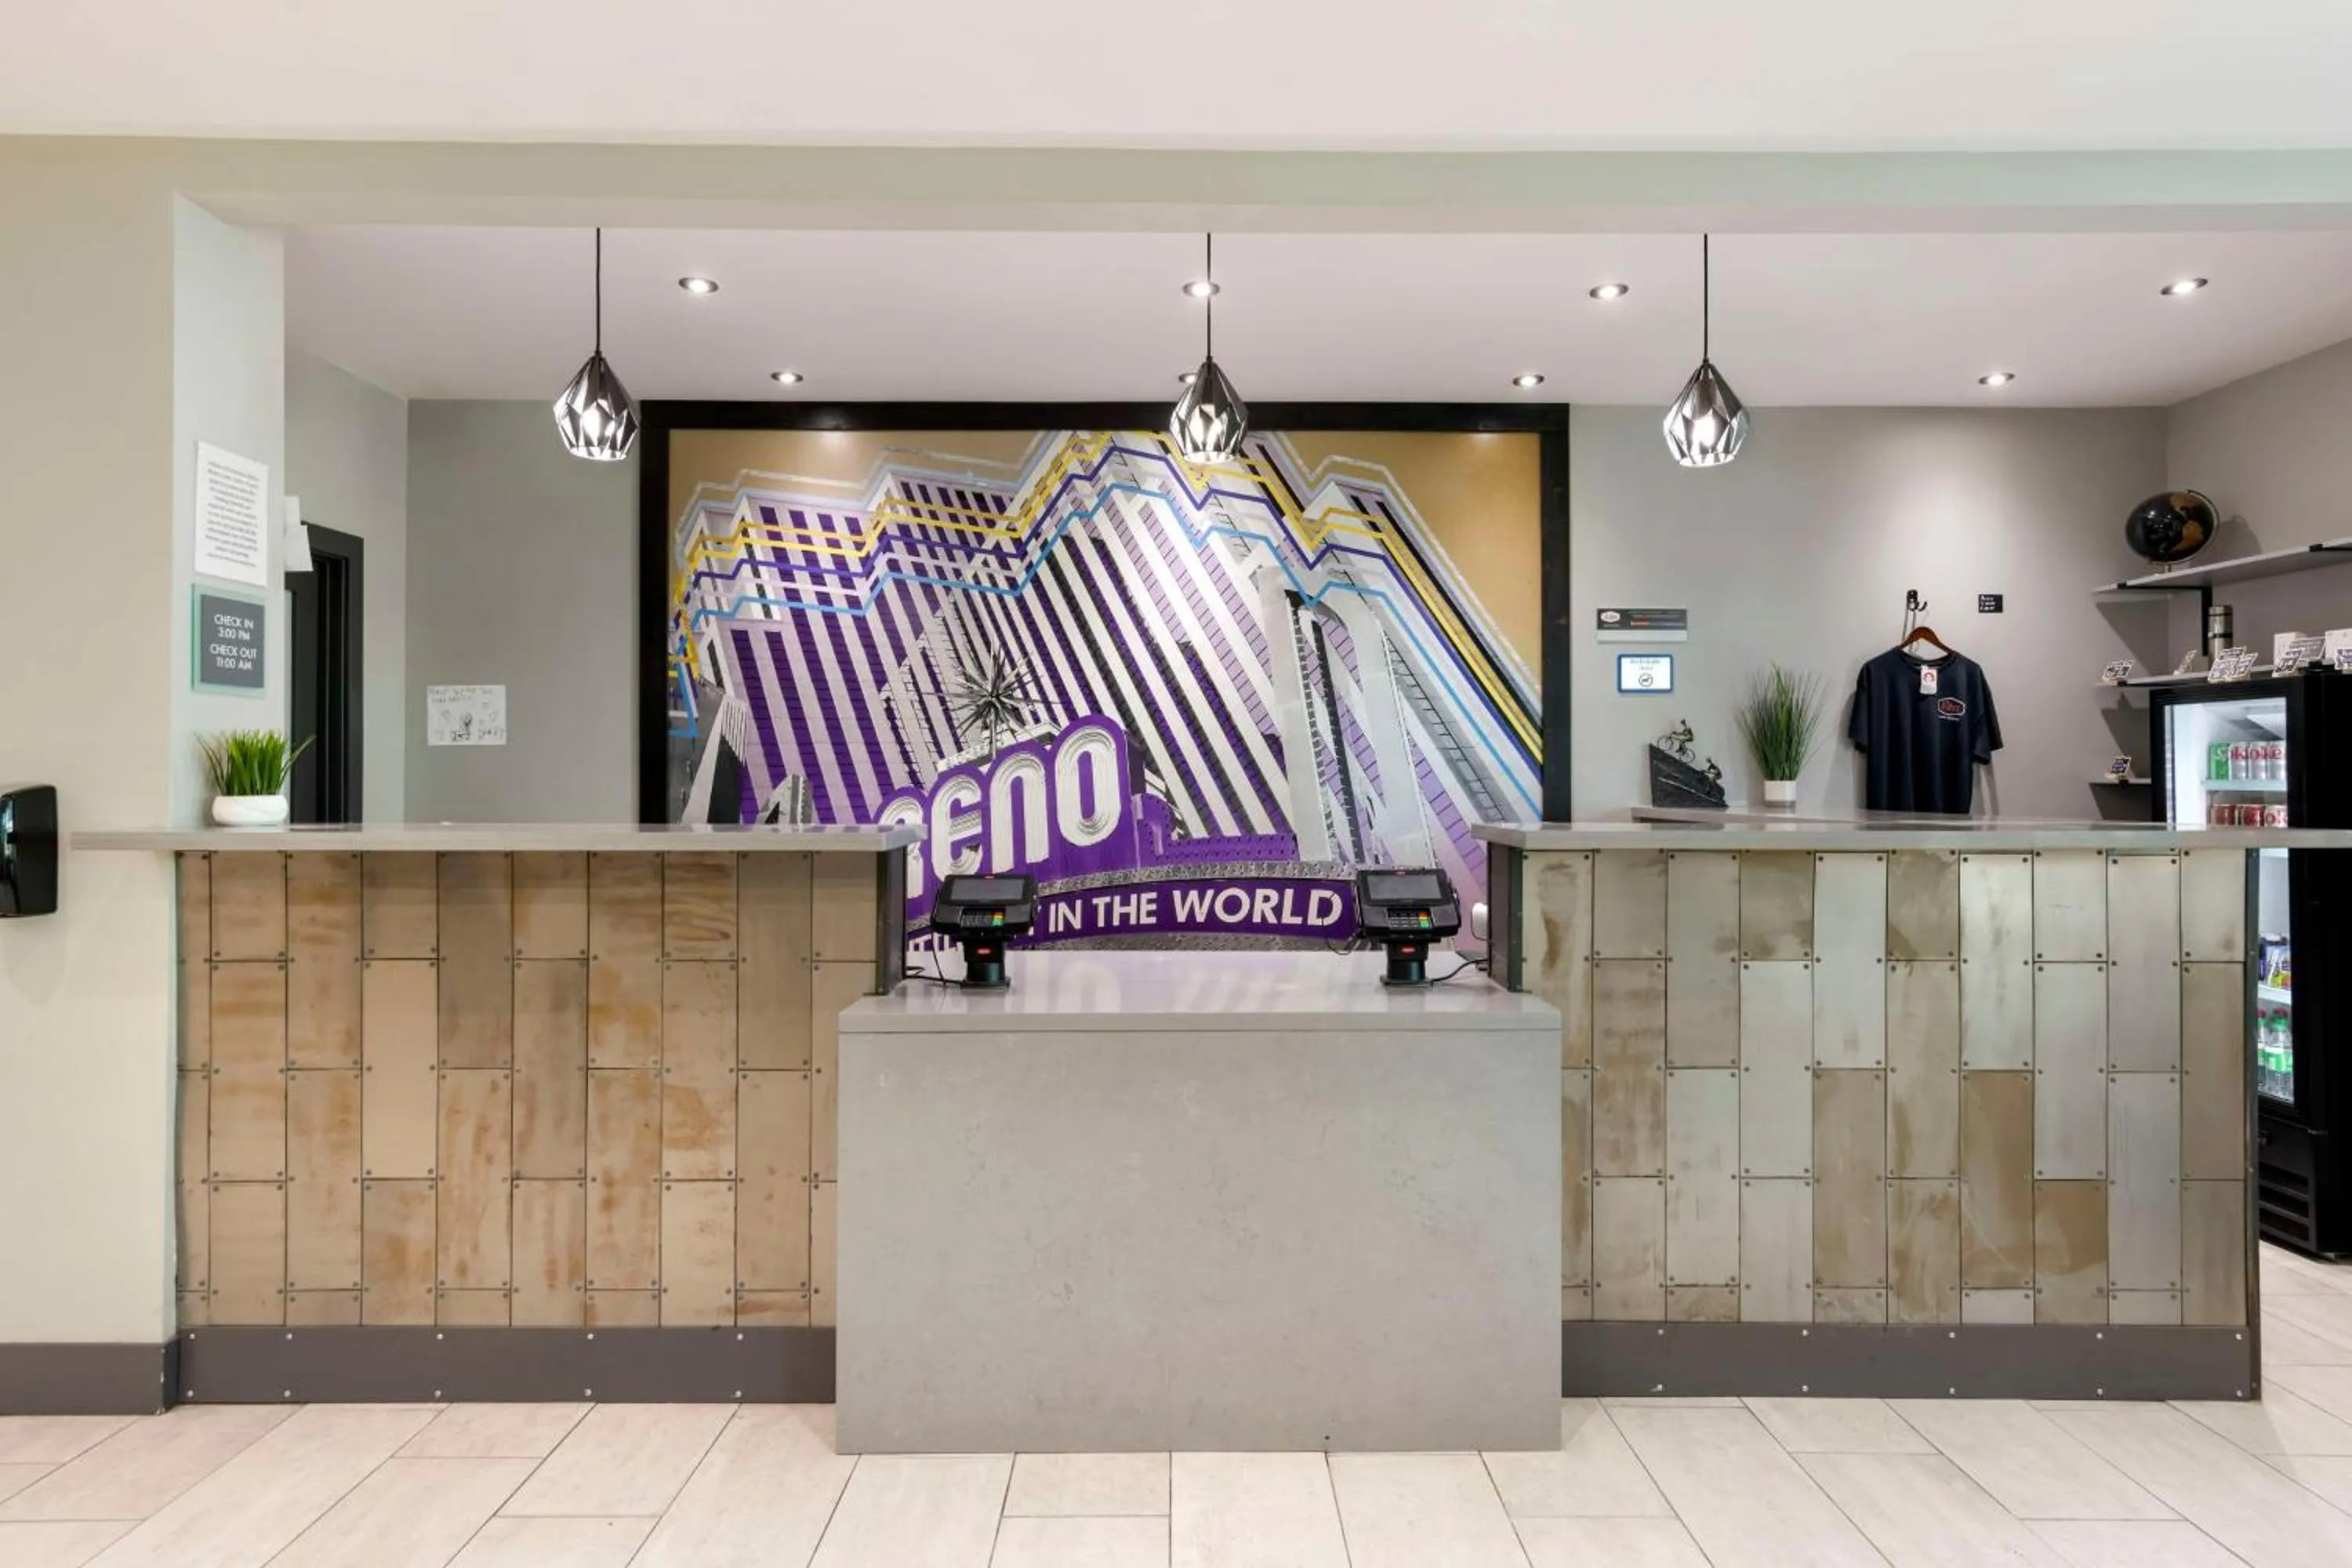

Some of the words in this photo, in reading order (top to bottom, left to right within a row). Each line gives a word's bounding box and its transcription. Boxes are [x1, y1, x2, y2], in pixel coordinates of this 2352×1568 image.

[214, 614, 242, 627] CHECK
[244, 618, 253, 629] IN
[238, 630, 250, 641] PM
[209, 644, 238, 656] CHECK
[240, 647, 257, 659] OUT
[238, 659, 252, 670] AM
[1048, 899, 1082, 933] IN
[1092, 892, 1158, 927] THE
[1173, 887, 1343, 926] WORLD
